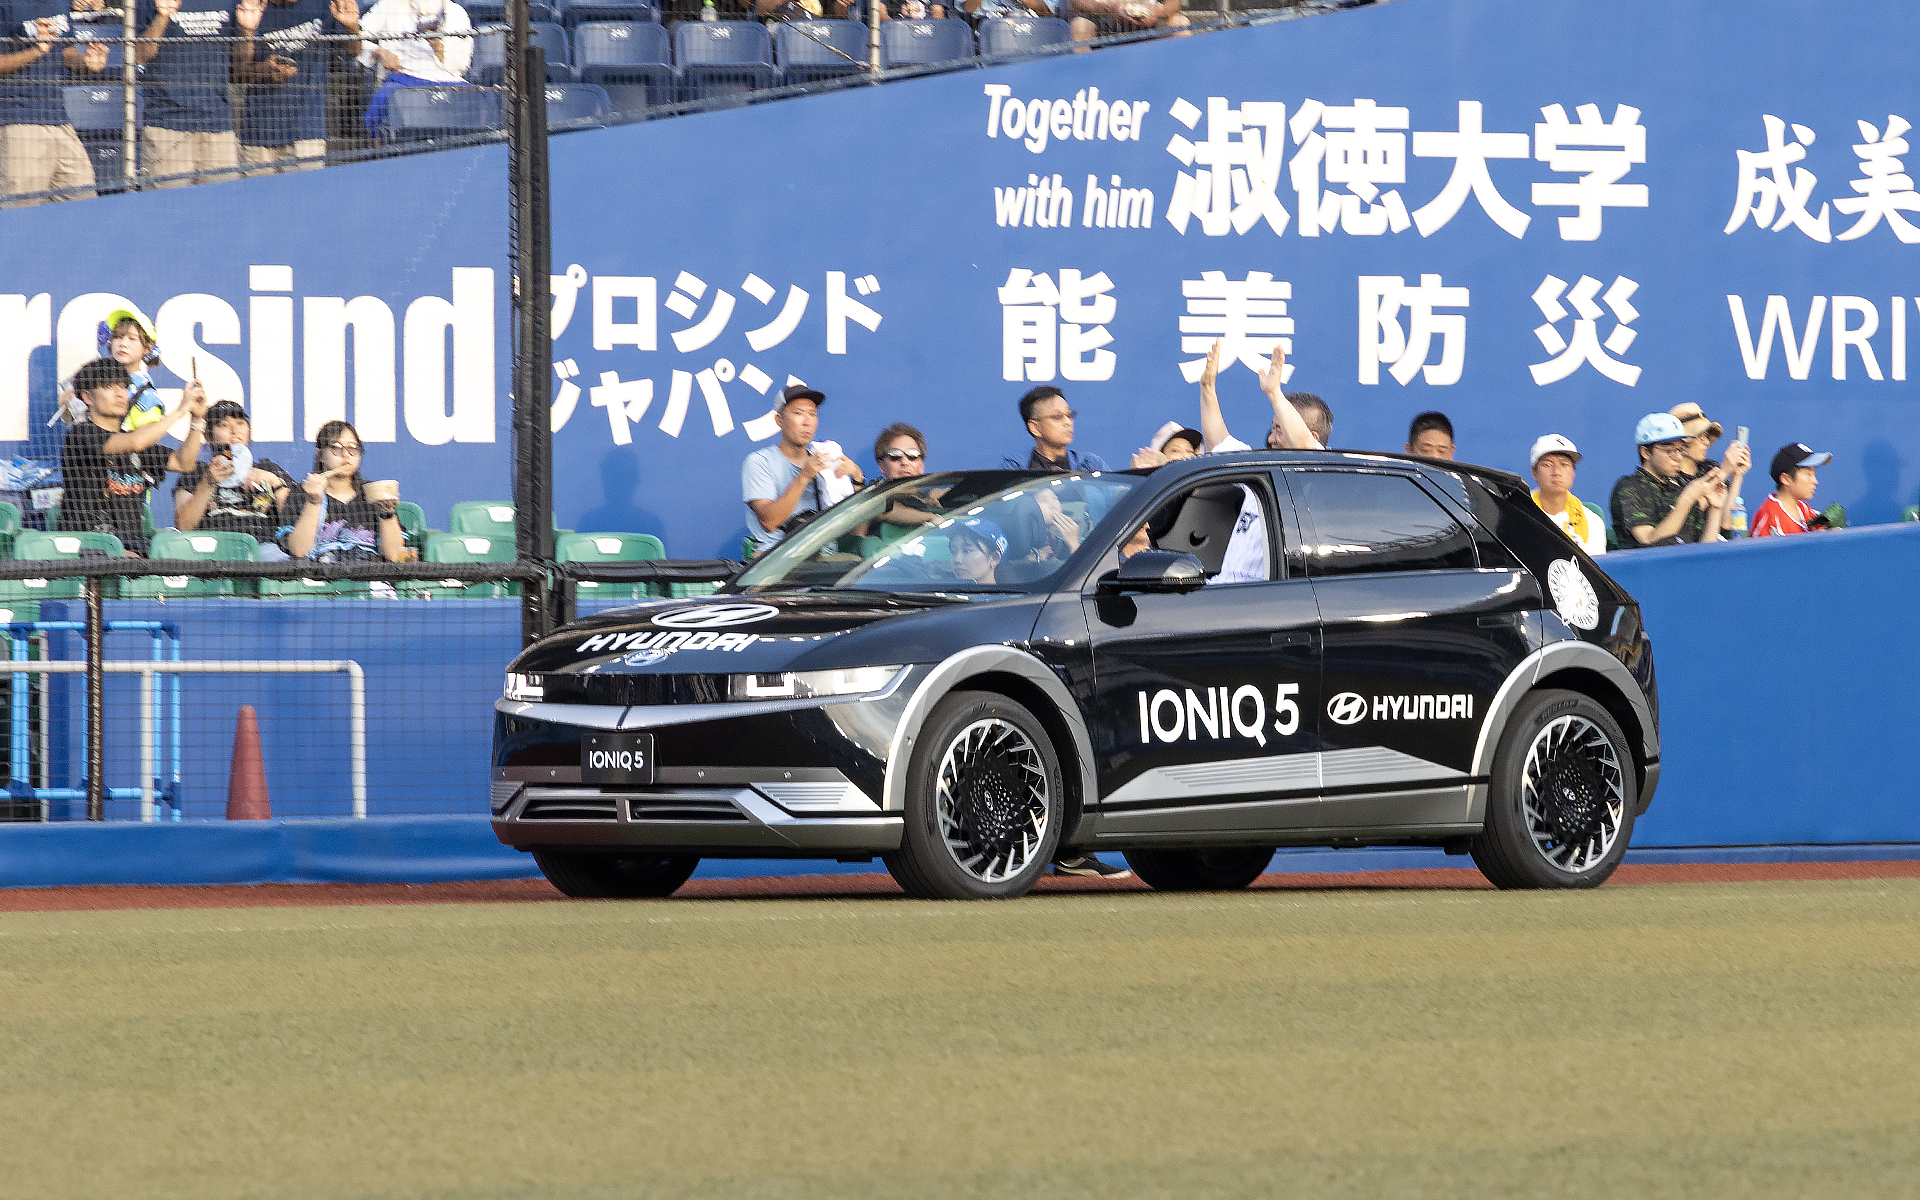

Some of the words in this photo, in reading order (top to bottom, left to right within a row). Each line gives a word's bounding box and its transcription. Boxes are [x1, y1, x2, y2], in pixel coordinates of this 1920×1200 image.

[984, 84, 1150, 154] Together
[994, 174, 1073, 229] with
[1083, 174, 1155, 229] him
[1166, 97, 1649, 242] 淑徳大学
[1724, 114, 1920, 244] 成美
[549, 263, 884, 355] プロシンド
[998, 267, 1643, 387] 能美防災
[1727, 294, 1920, 381] WRI
[576, 631, 760, 653] HYUNDAI
[1138, 684, 1267, 747] IONIQ
[1273, 682, 1300, 736] 5
[1372, 694, 1474, 721] HYUNDAI
[589, 750, 632, 771] IONIQ
[634, 750, 644, 769] 5
